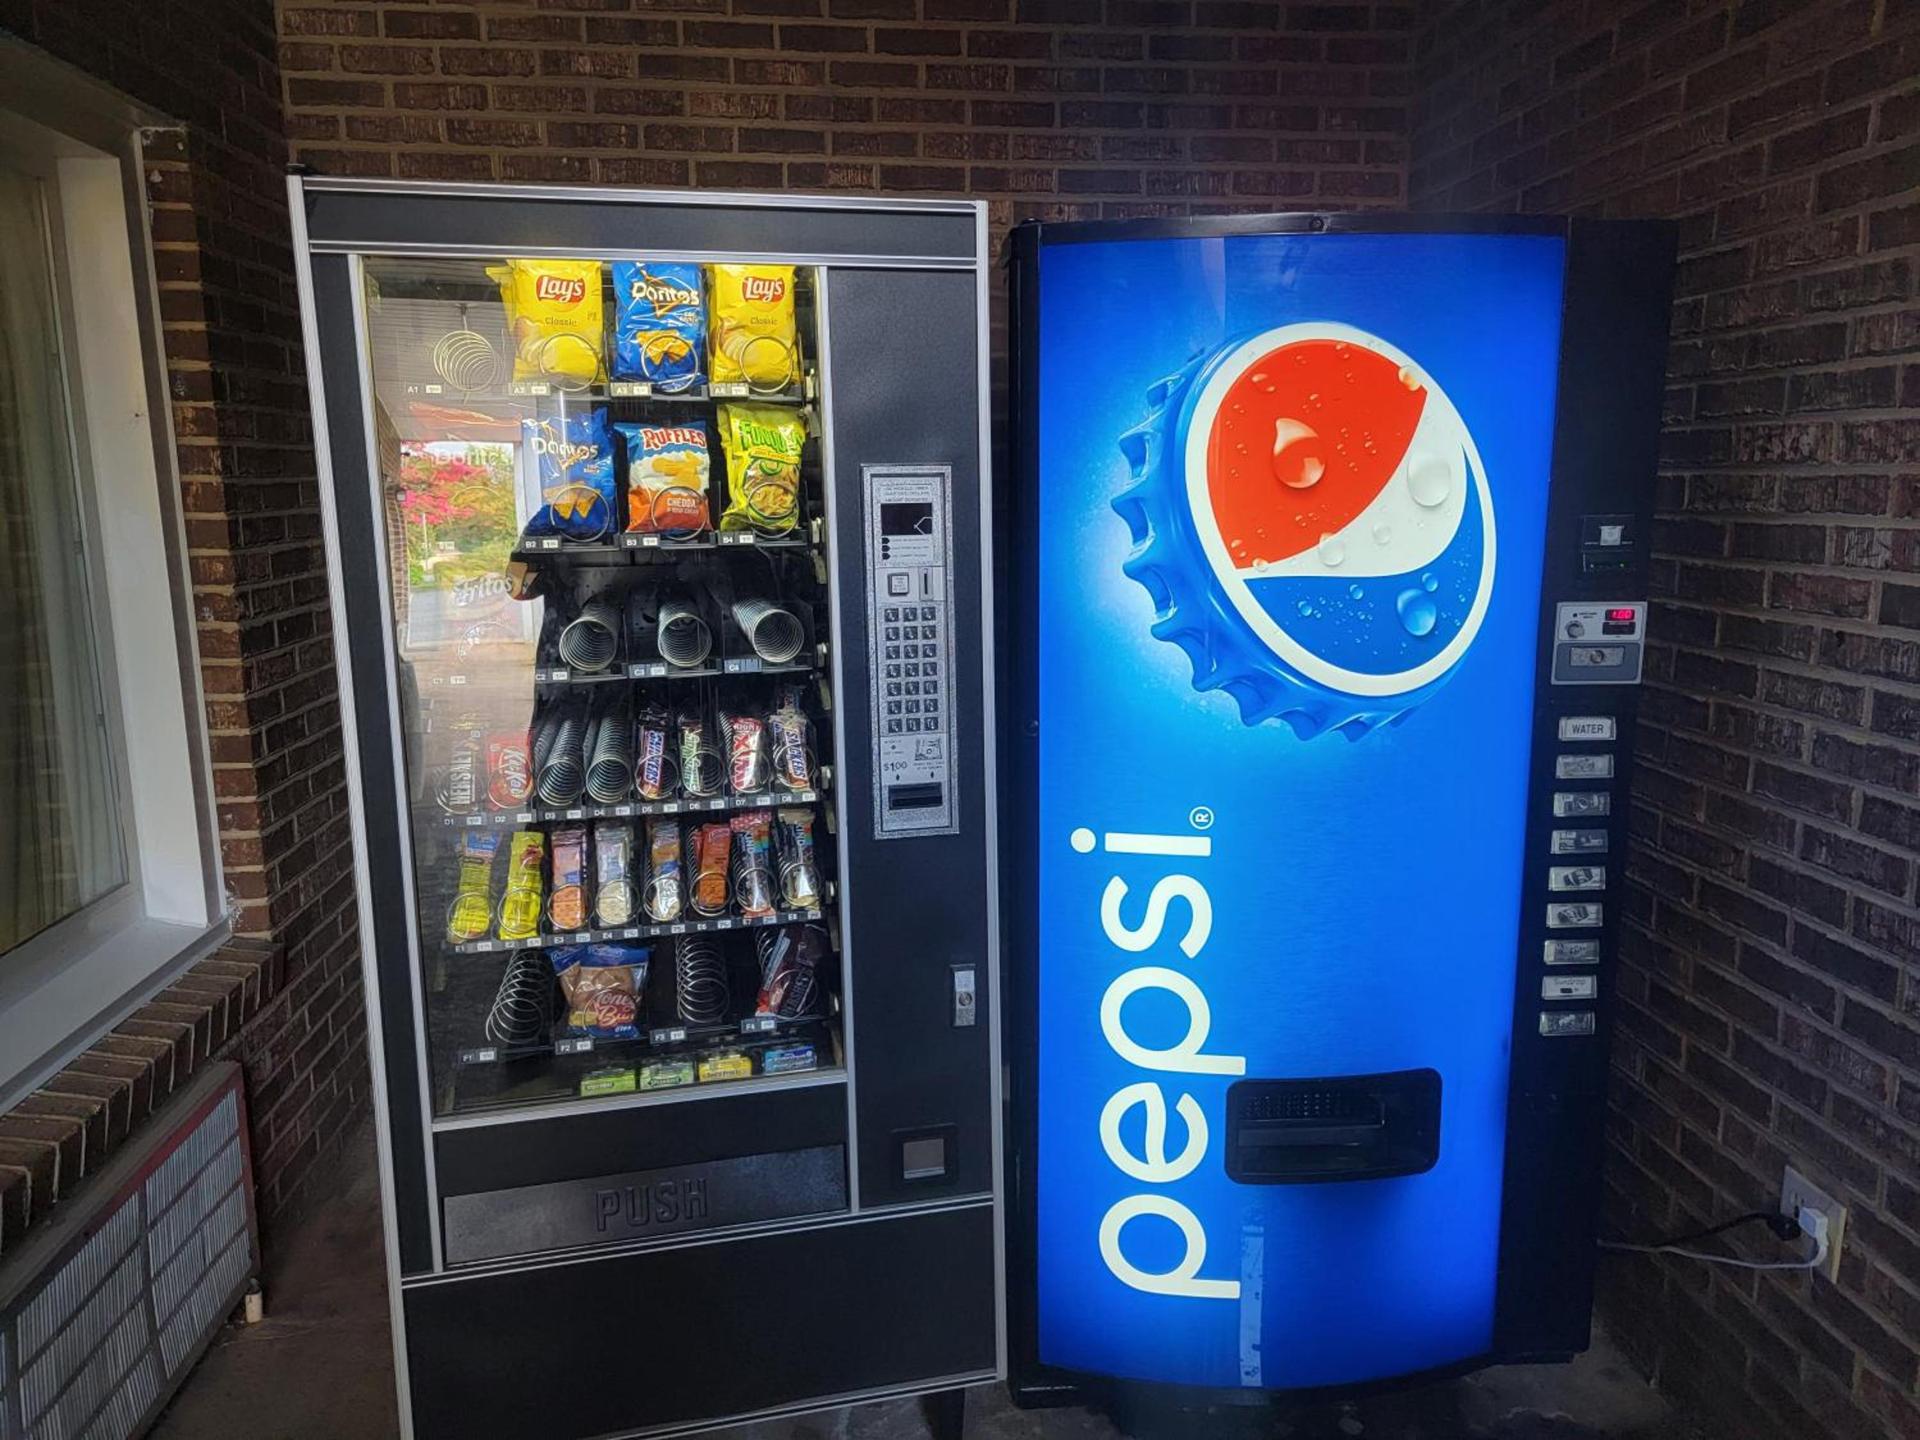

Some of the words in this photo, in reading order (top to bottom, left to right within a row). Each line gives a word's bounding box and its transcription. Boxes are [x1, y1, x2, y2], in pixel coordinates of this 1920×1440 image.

[631, 281, 700, 306] Doritos
[544, 316, 578, 327] Classic
[642, 427, 707, 450] RUFFLES
[739, 420, 803, 454] FUNYU
[1571, 723, 1605, 735] WATER
[450, 744, 473, 805] HERSHEY
[645, 730, 665, 786] SNICKERS
[786, 731, 807, 779] SNICKERS
[1070, 827, 1247, 1299] pepsi
[594, 1176, 709, 1233] PUSH
